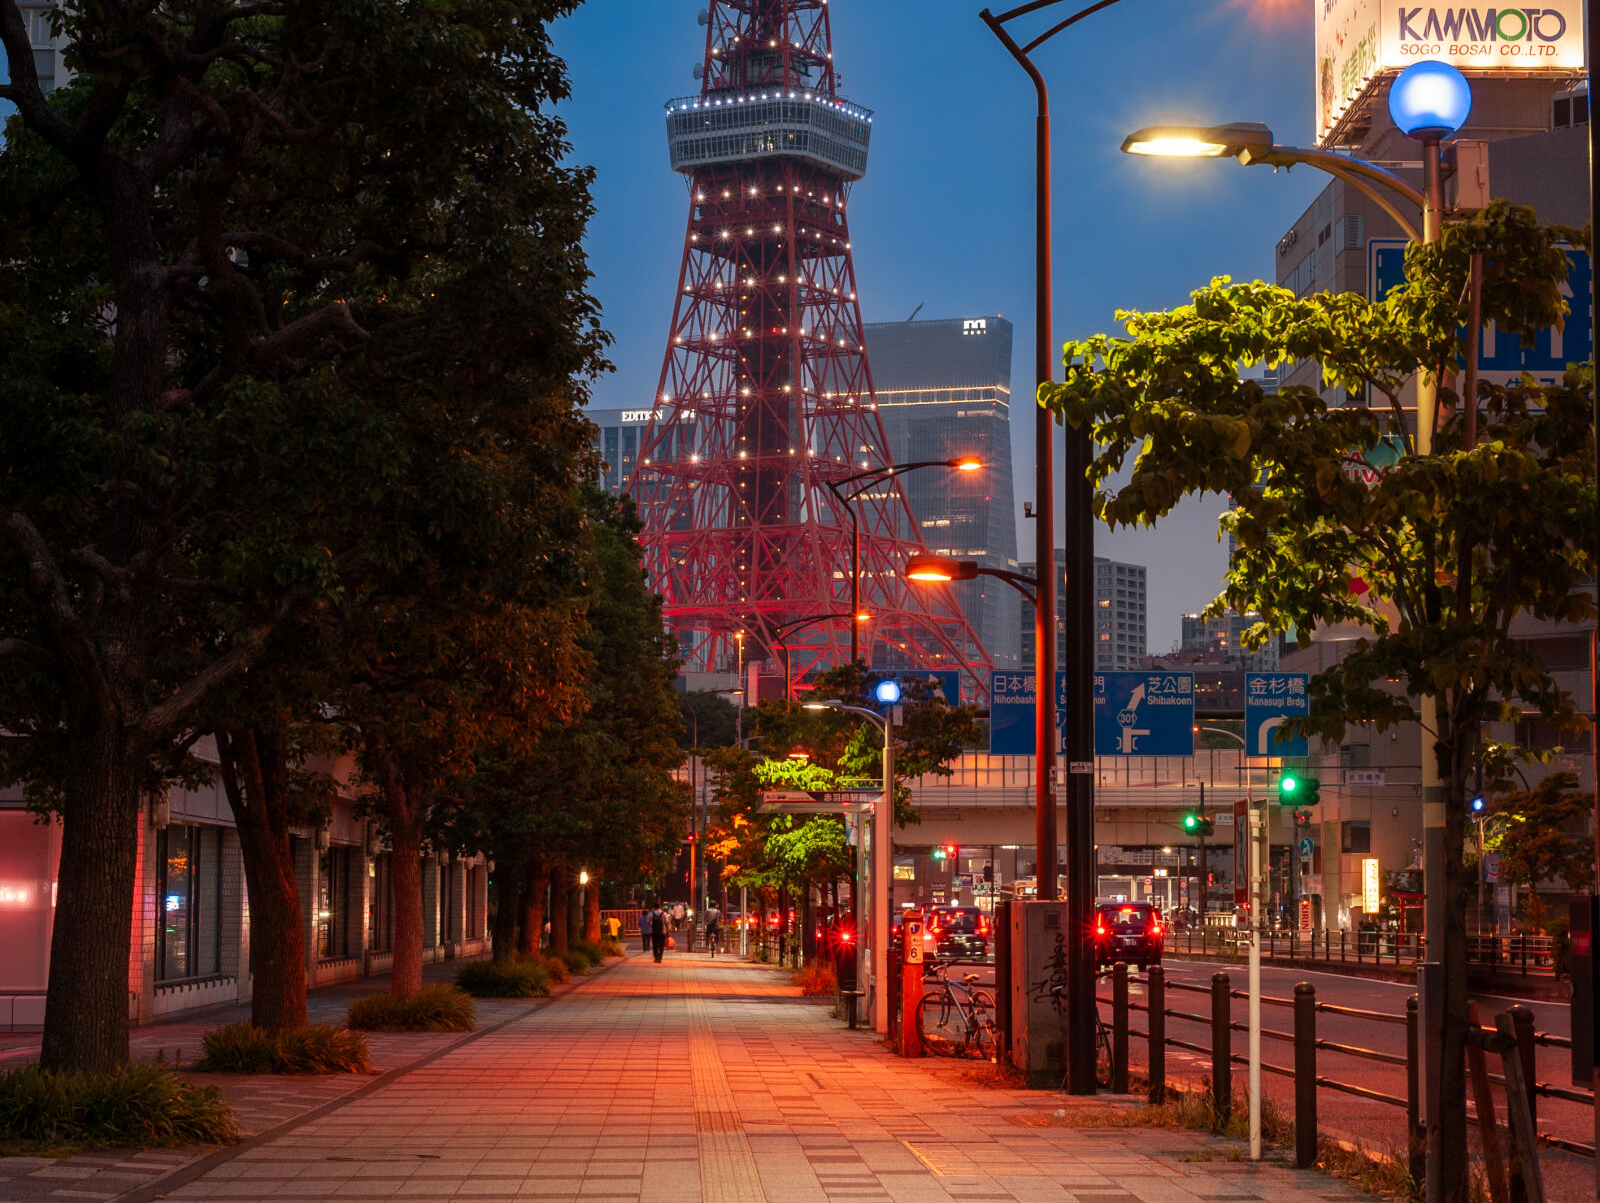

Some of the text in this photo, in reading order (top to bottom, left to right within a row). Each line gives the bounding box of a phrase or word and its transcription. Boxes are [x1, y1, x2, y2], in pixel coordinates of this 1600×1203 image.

[1400, 44, 1441, 55] SOGO
[1449, 45, 1492, 55] BOSAI
[994, 675, 1036, 693] 日本橋
[1147, 676, 1191, 694] 芝公園
[1249, 677, 1305, 695] 金杉橋
[1147, 695, 1192, 706] Shibakoen
[1248, 696, 1284, 708] Kanasugi
[1120, 713, 1136, 724] 301
[1301, 902, 1309, 930] KIRIN
[910, 947, 918, 958] 6
